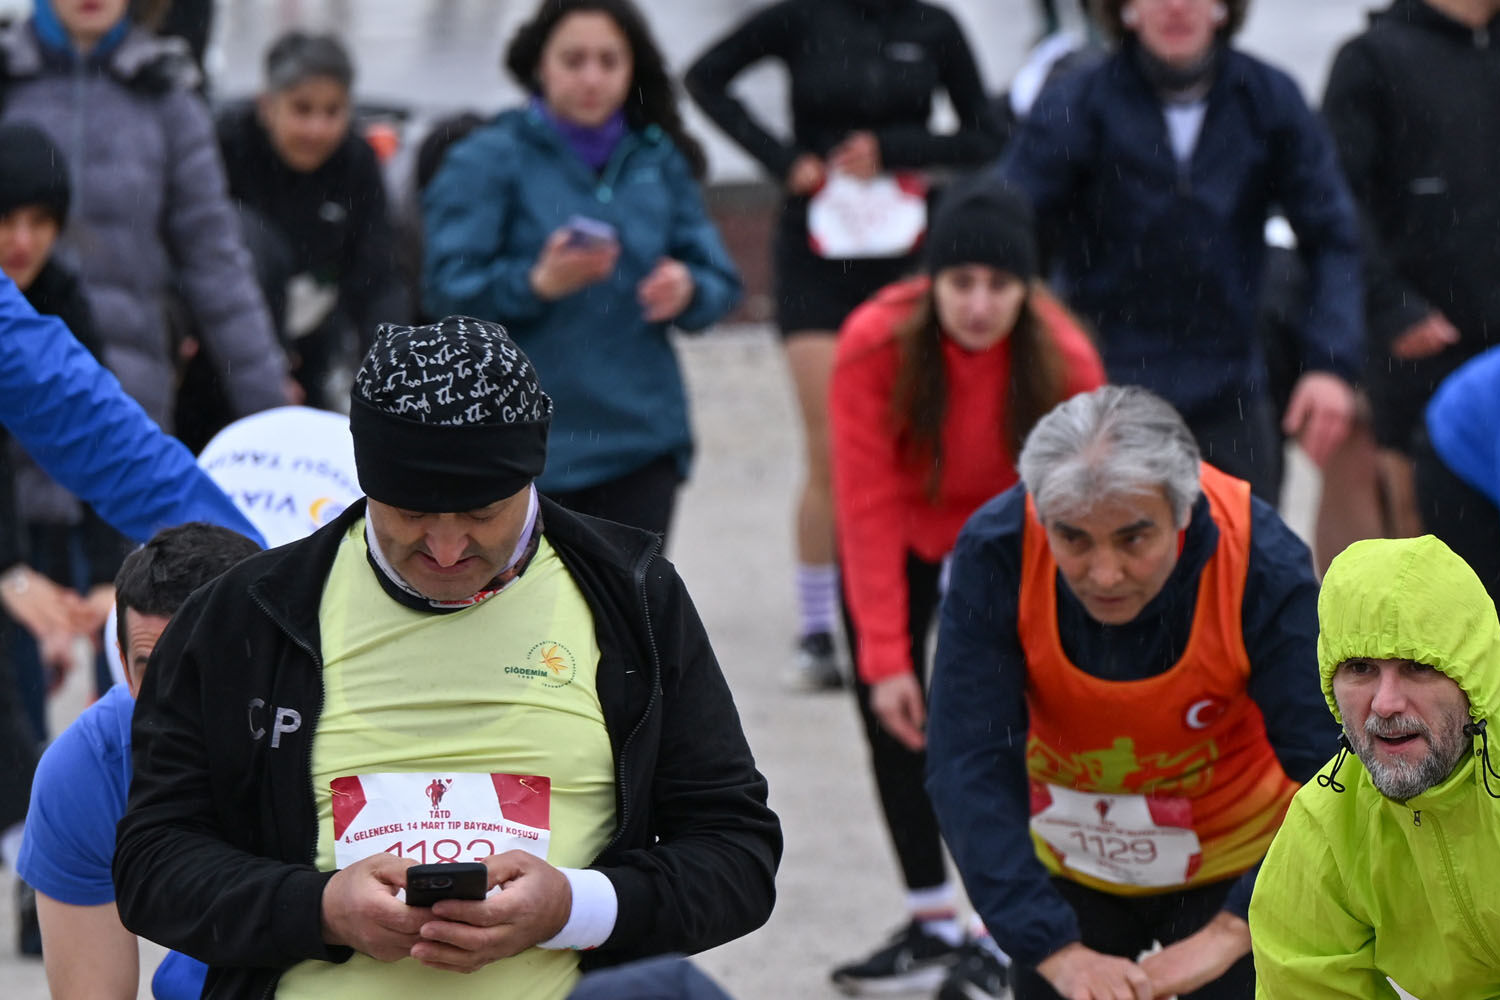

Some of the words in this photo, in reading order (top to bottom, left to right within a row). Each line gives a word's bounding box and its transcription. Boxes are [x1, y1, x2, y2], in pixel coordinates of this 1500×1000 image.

[429, 810, 451, 819] TATD
[345, 835, 353, 845] 4.
[353, 823, 404, 842] GELENEKSEL
[407, 822, 418, 831] 14
[420, 821, 445, 830] MART
[448, 821, 461, 830] TIP
[463, 821, 503, 833] BAYRAMI
[505, 826, 540, 841] KOŞUSU
[1070, 830, 1158, 865] 1129
